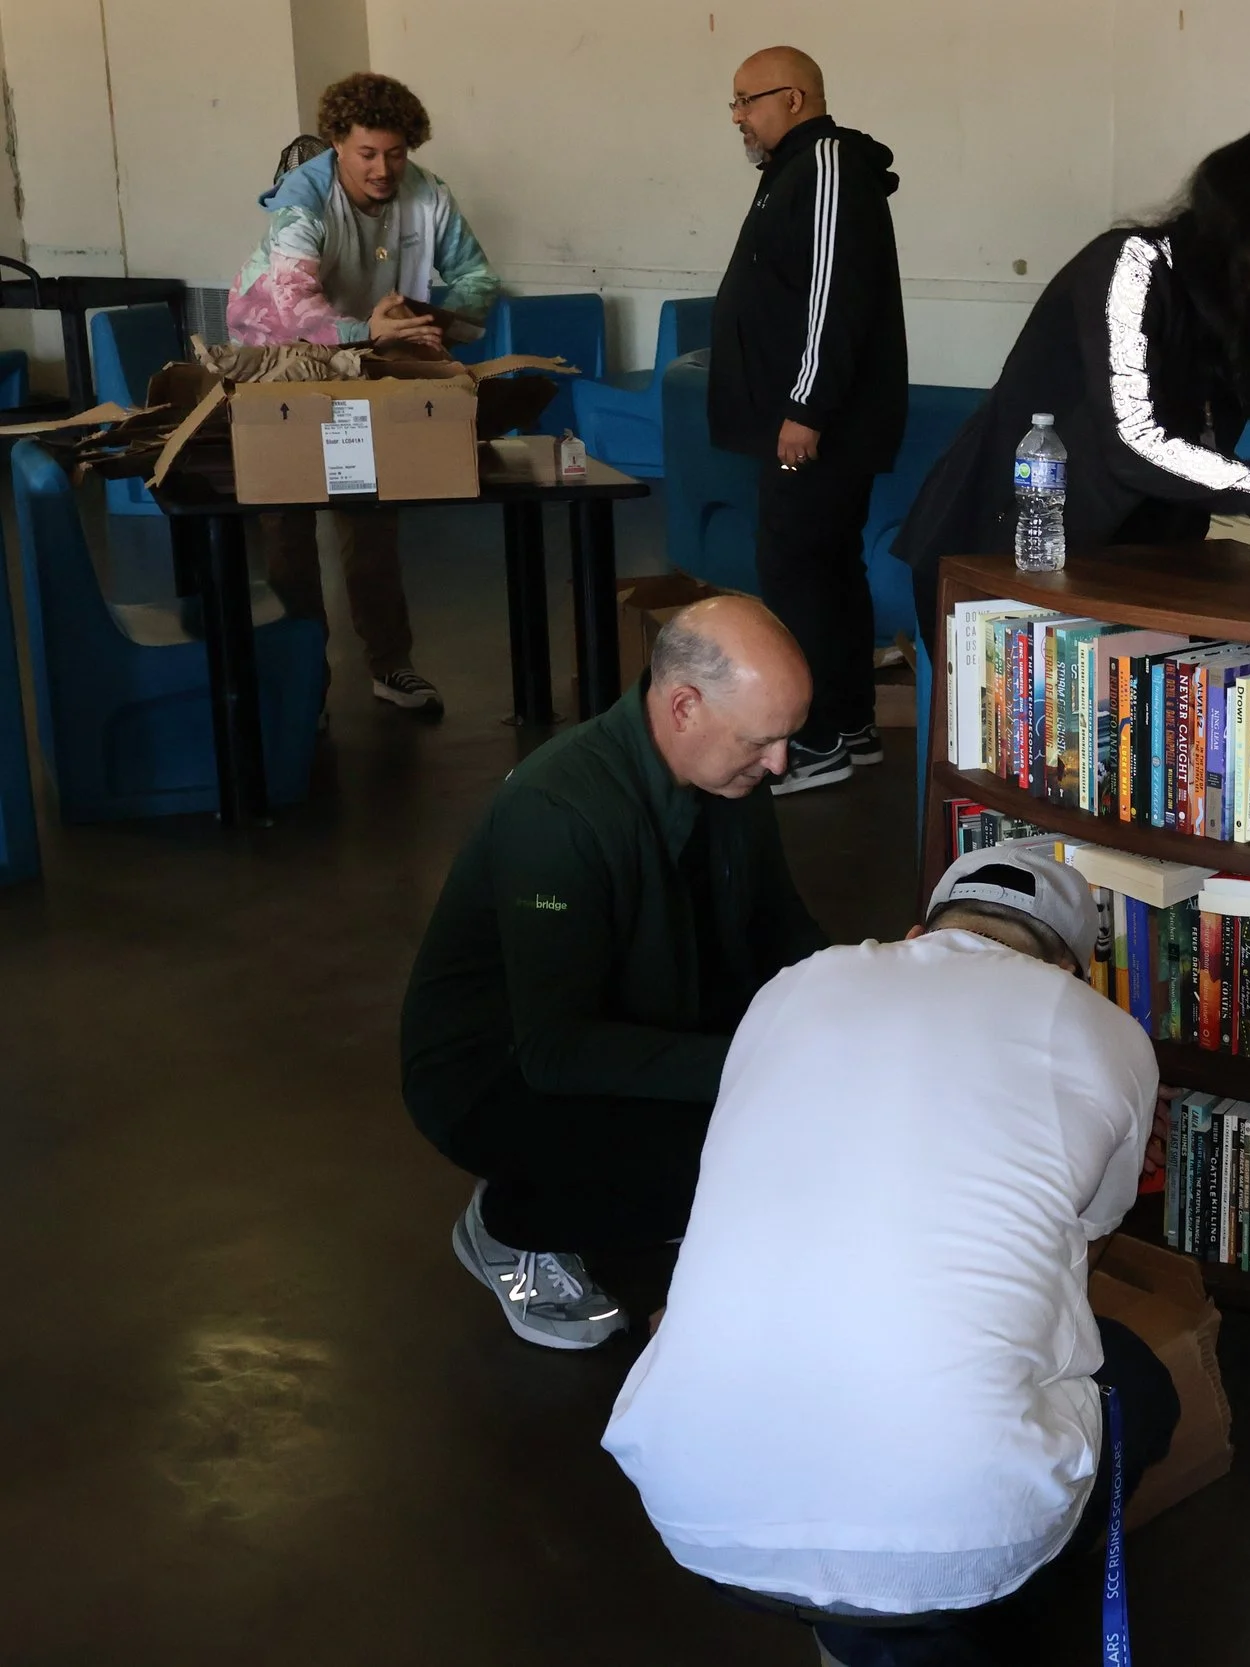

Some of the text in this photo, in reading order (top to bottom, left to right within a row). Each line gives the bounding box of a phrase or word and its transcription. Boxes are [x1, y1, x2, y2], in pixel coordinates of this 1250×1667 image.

[1057, 661, 1066, 696] STORM
[1166, 663, 1176, 675] THE
[1045, 654, 1053, 748] TRAIL OF LIGHTNING
[1057, 699, 1066, 712] OF
[1166, 679, 1175, 698] DEVIL
[1237, 686, 1245, 724] Drown
[1110, 676, 1119, 768] RUDOLFO ANAYA
[1166, 710, 1175, 727] DAVE
[1178, 675, 1188, 783] NEVER CAUGHT
[536, 893, 568, 911] bridge
[1221, 981, 1229, 1019] COATES
[1106, 1440, 1123, 1599] SCC RISING SCHOLARS
